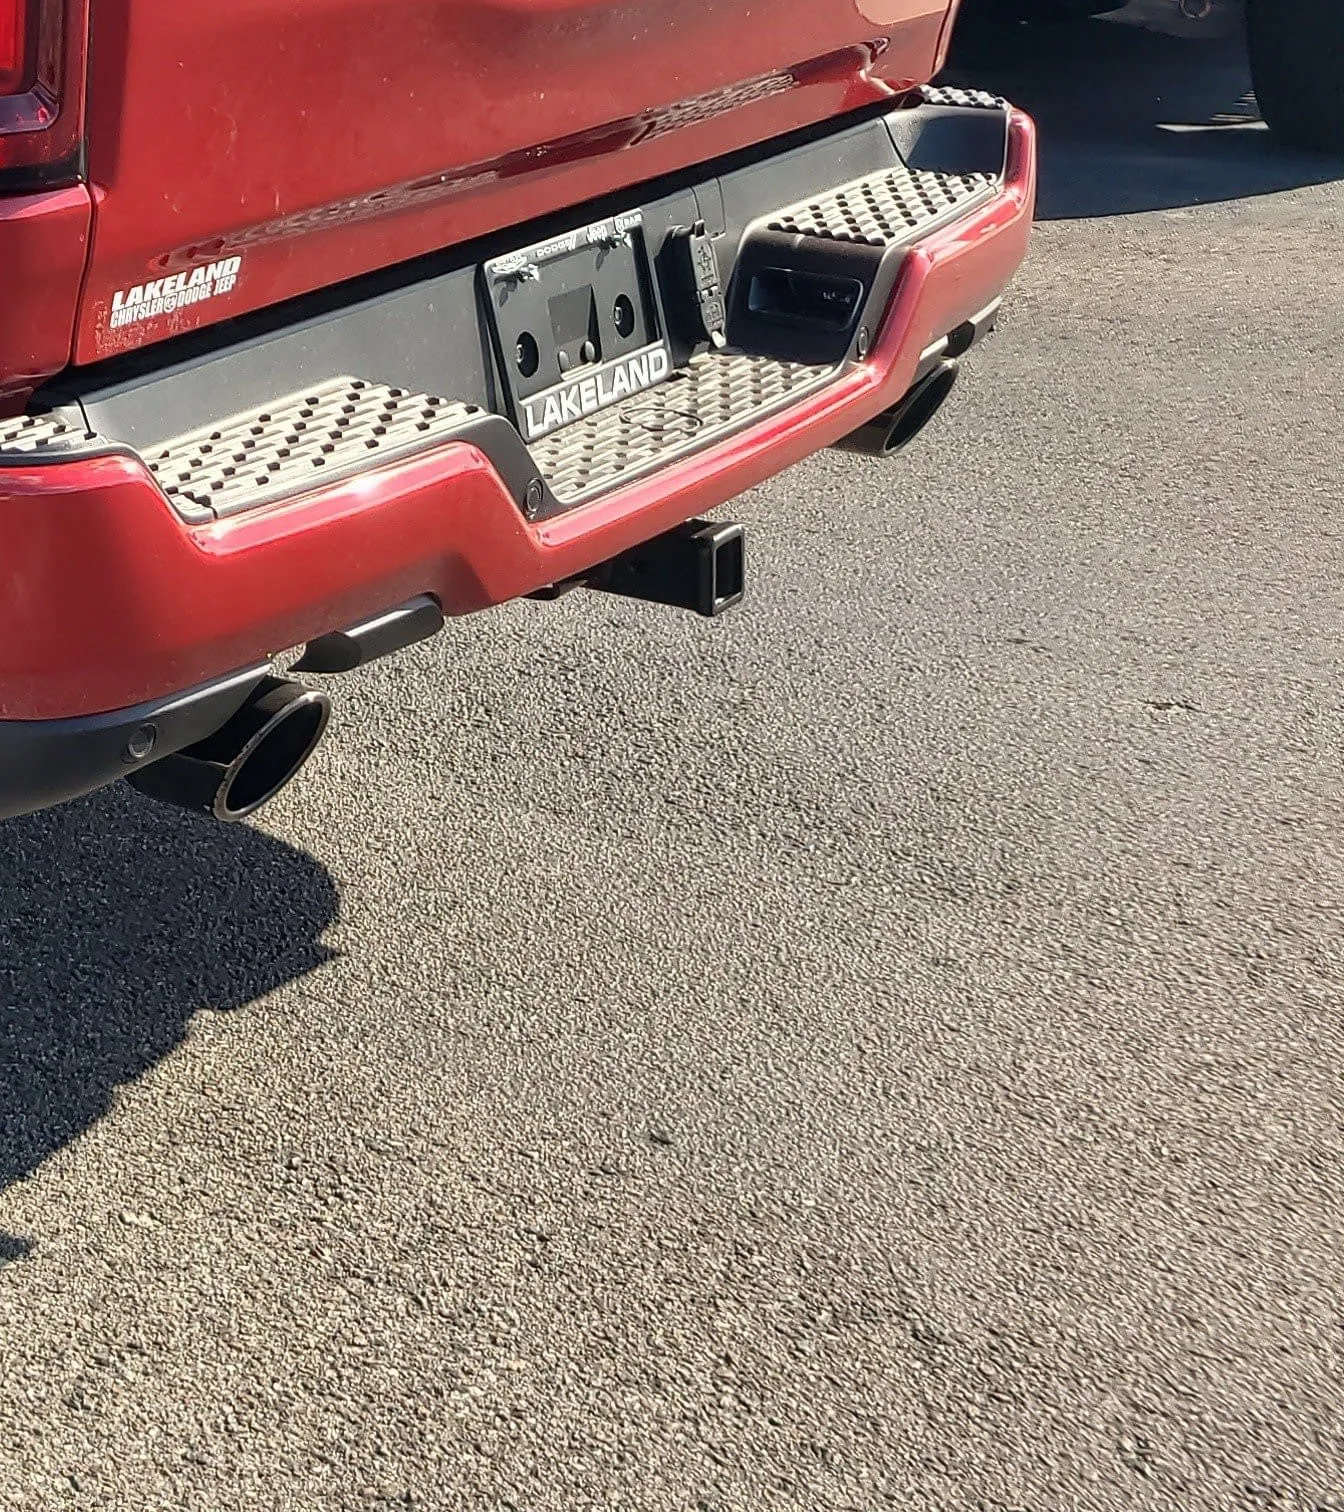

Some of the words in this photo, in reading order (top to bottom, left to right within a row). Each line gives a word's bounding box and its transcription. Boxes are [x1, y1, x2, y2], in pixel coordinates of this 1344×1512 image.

[109, 296, 163, 329] CHRYSLER
[176, 282, 212, 308] DODGE
[213, 274, 237, 296] JEEP
[111, 256, 242, 311] LAKELAND
[525, 347, 668, 438] LAKELAND
